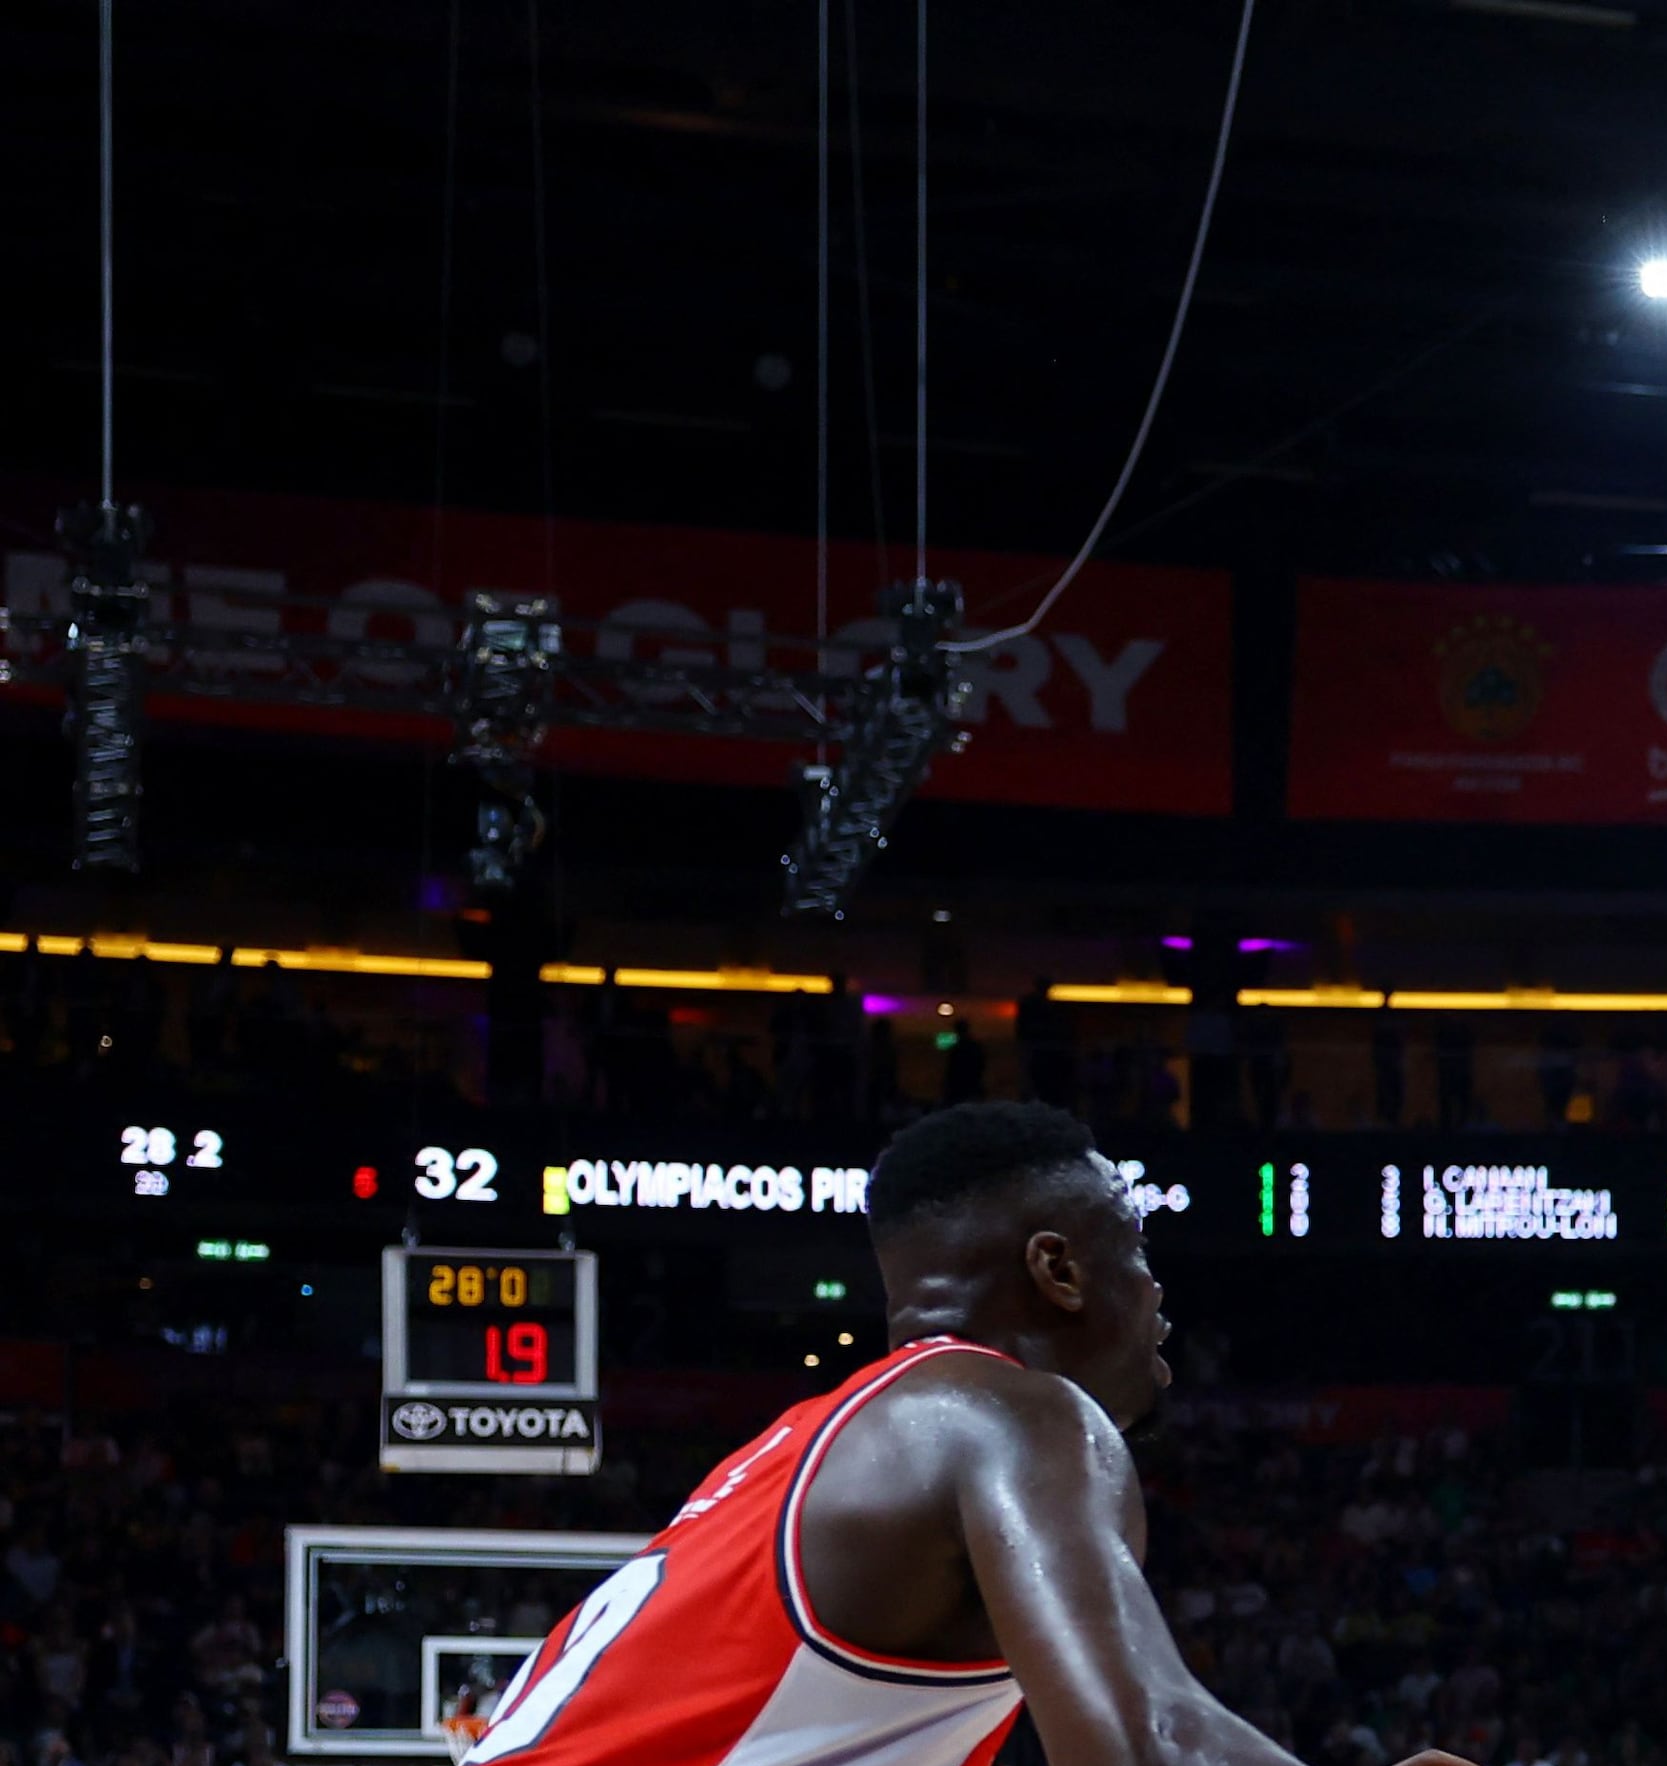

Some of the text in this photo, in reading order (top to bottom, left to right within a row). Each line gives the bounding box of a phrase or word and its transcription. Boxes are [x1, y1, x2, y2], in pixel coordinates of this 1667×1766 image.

[120, 1125, 177, 1166] 28
[413, 1145, 499, 1202] 32
[566, 1158, 806, 1212] OLYMPIACOS
[448, 1406, 591, 1438] TOYOTA
